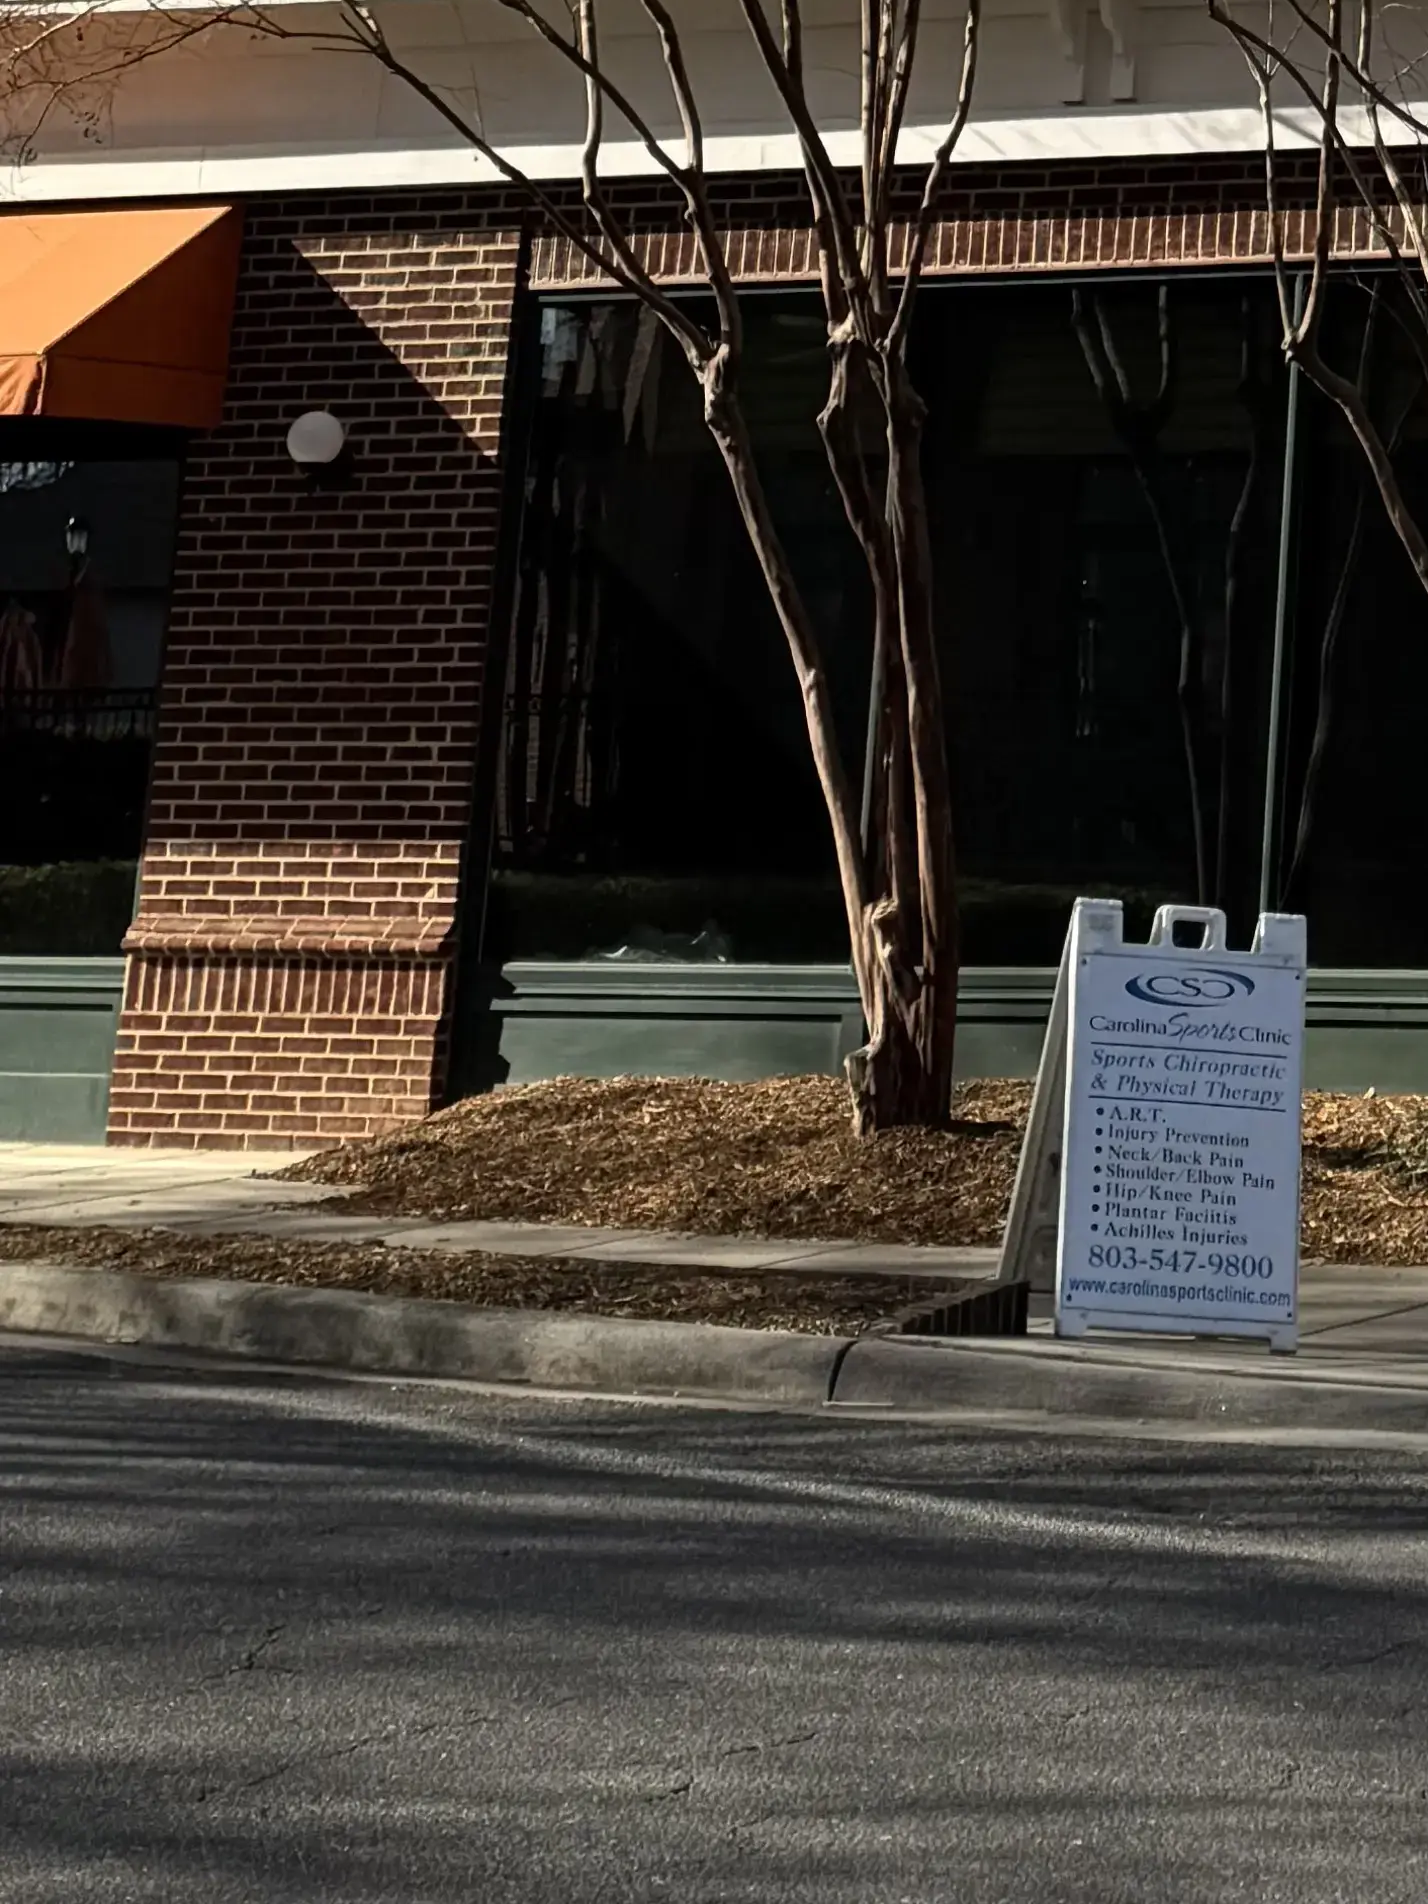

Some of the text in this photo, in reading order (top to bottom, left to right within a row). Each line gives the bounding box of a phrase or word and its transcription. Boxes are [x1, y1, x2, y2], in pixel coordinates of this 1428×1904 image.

[1089, 1012, 1292, 1045] Carolina Sports Clinic
[1091, 1049, 1287, 1079] Sports Chiropractic
[1090, 1072, 1285, 1106] & Physical Therapy
[1109, 1106, 1167, 1123] A.R.T.
[1108, 1124, 1250, 1148] Injury Prevention
[1108, 1145, 1244, 1168] Neck/Back Pain
[1105, 1163, 1275, 1190] Shoulder/Elbow Pain
[1105, 1182, 1237, 1206] Hip/Knee Pain
[1105, 1202, 1167, 1221] Plantar
[1104, 1221, 1249, 1246] Achilles Injuries
[1088, 1244, 1273, 1279] 803-547-9800
[1069, 1277, 1291, 1307] www.carolinasportsclinic.com
